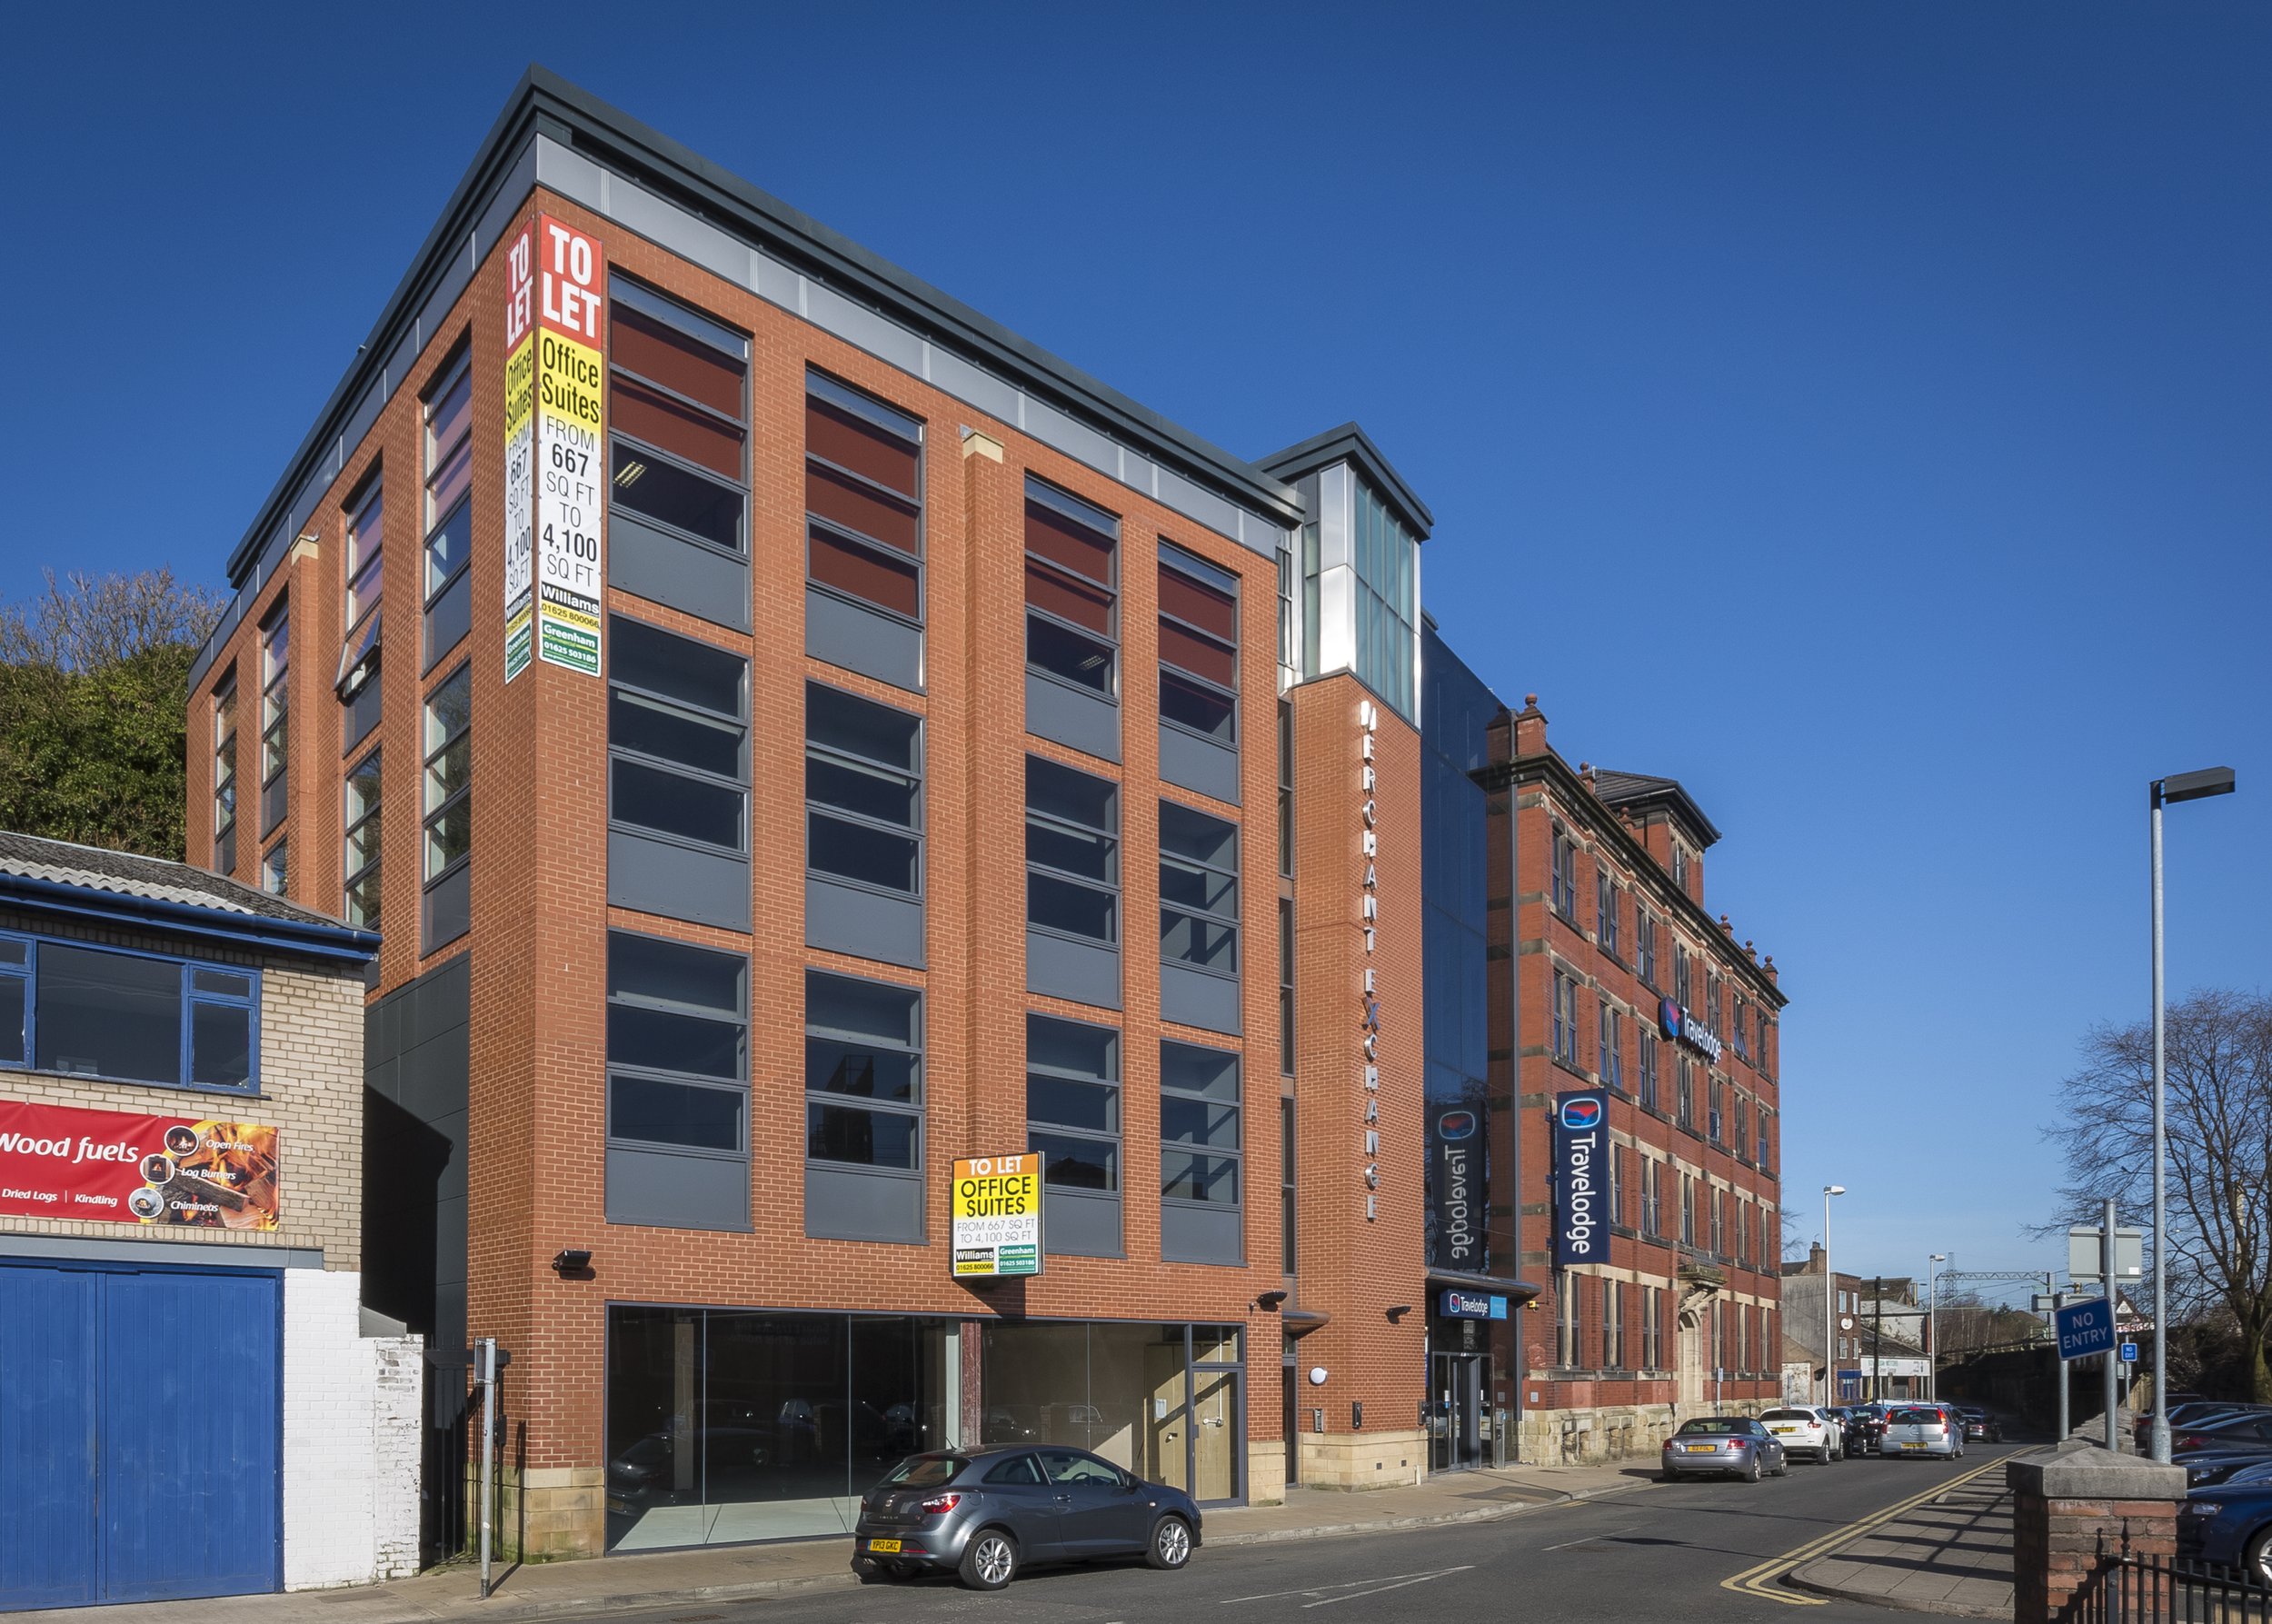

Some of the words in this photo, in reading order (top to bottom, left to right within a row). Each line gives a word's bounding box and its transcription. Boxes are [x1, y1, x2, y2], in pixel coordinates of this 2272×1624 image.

[510, 233, 529, 294] TO
[549, 224, 592, 285] TO
[507, 274, 533, 349] LET
[543, 271, 601, 338] LET
[507, 349, 532, 396] Office
[543, 337, 599, 388] Office
[507, 384, 532, 433] Suites
[542, 373, 599, 423] Suites
[508, 419, 531, 460] FROM
[546, 415, 594, 453] FROM
[511, 447, 528, 485] 667
[552, 443, 589, 477] 667
[508, 488, 518, 514] SQ
[521, 474, 530, 502] FT
[546, 471, 570, 498] SQ
[576, 483, 594, 505] FT
[513, 508, 523, 533] TO
[559, 502, 581, 528] TO
[507, 525, 531, 569] 4,100
[543, 523, 597, 563] 4,100
[508, 569, 519, 594] SQ
[520, 557, 530, 583] FT
[546, 554, 570, 581] SQ
[575, 564, 594, 587] FT
[542, 583, 599, 614] Williams
[541, 603, 567, 618] 01625
[569, 612, 600, 628] 800066
[543, 623, 595, 648] Greenham
[543, 642, 567, 654] 01625
[568, 649, 596, 663] 503186
[1682, 1006, 1721, 1063] Travelodge
[1362, 968, 1380, 1220] EXCHANGE
[0, 1133, 71, 1157] Wood
[72, 1137, 139, 1163] fuels
[205, 1140, 231, 1151] Open
[181, 1168, 199, 1179] Log
[201, 1169, 236, 1180] Burners
[969, 1158, 992, 1176] TO
[997, 1155, 1023, 1174] LET
[2, 1188, 31, 1200] Dried
[33, 1191, 57, 1203] Logs
[75, 1194, 118, 1208] Kindling
[961, 1176, 1031, 1198] OFFICE
[1566, 1131, 1597, 1254] Travelodge
[170, 1201, 219, 1212] Chimineas
[966, 1196, 1025, 1218] SUITES
[957, 1221, 984, 1232] FROM
[988, 1220, 1005, 1230] 667
[1009, 1219, 1022, 1230] SQ
[1025, 1219, 1035, 1229] FT
[961, 1233, 972, 1243] TO
[975, 1232, 1002, 1243] 4,100
[1005, 1231, 1019, 1241] SQ
[1021, 1230, 1031, 1240] FT
[956, 1250, 994, 1260] Williams
[1000, 1247, 1034, 1255] Greenham
[1460, 1296, 1488, 1316] Travelodge
[2072, 1312, 2094, 1330] NO
[2063, 1327, 2108, 1350] ENTRY
